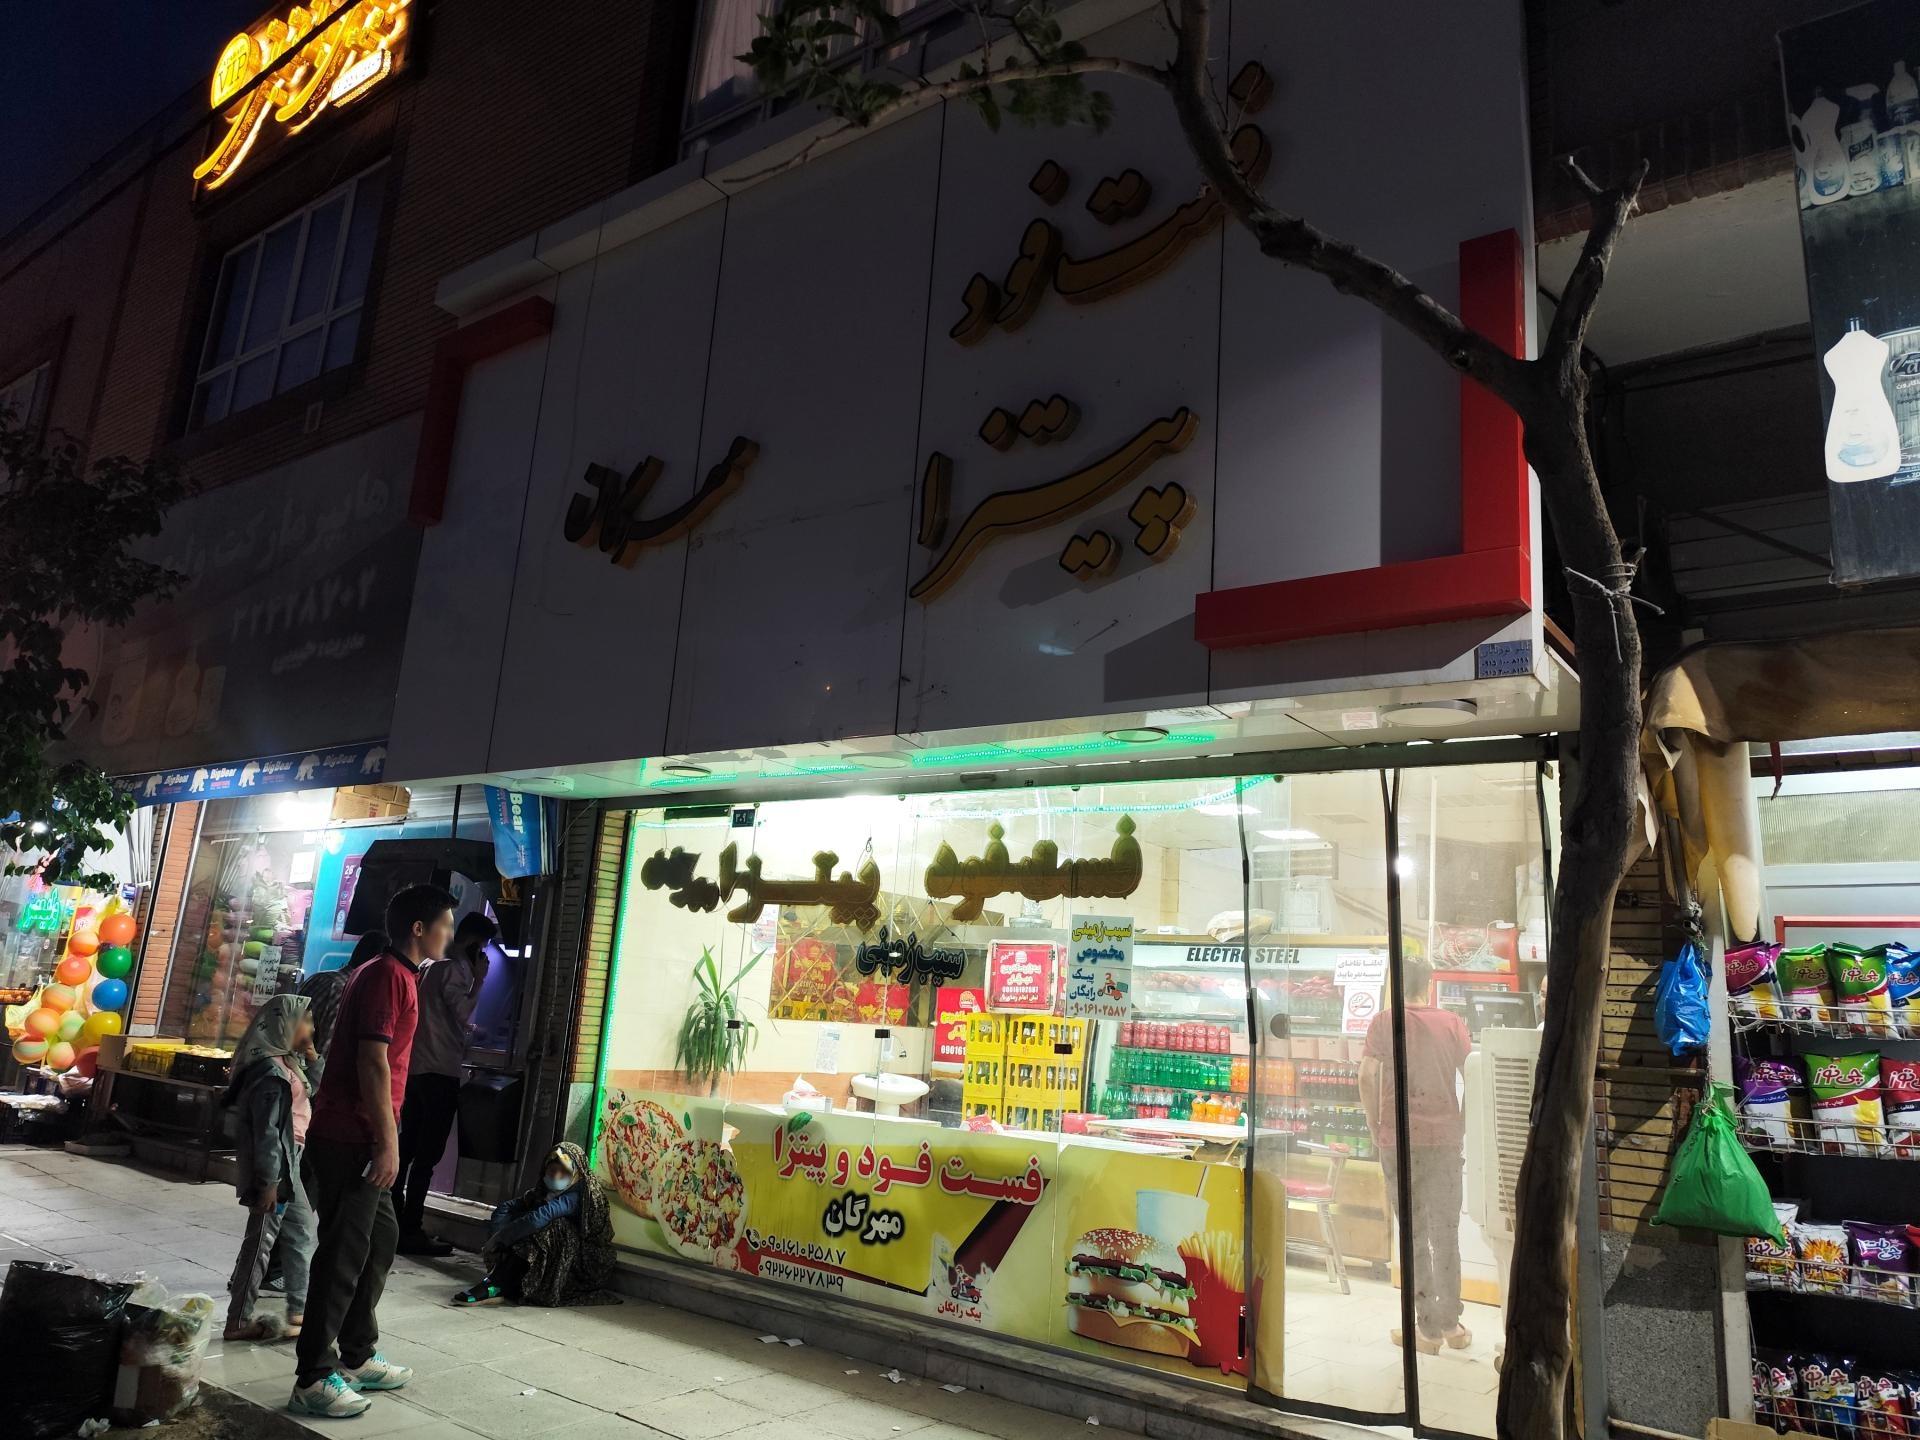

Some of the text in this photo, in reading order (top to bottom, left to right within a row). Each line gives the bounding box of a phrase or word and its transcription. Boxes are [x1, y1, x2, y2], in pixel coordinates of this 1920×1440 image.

[217, 51, 249, 94] VIP
[950, 159, 1070, 347] فود
[564, 436, 760, 571] مهرگان
[908, 393, 1200, 604] پیتزا
[210, 768, 238, 780] BigBear
[262, 760, 294, 774] BigBear
[509, 792, 525, 834] Bear
[1072, 921, 1132, 944] سیب زمینی
[856, 924, 966, 987] سیب زمینی
[1077, 945, 1125, 965] مخصوص
[1255, 948, 1300, 964] STEEL
[1071, 968, 1095, 985] پیک
[1069, 984, 1096, 1002] رایگان
[1070, 1001, 1127, 1017] ۰۹۰۱۶۱۰۲۵۸۷
[1814, 1063, 1864, 1086] چی توز
[773, 1123, 1047, 1207] فست فود و پیتزا
[826, 1195, 903, 1241] مهرگان
[761, 1236, 846, 1265] ۰۹۰۱۶۱۰۲۵۸۷
[758, 1260, 844, 1292] ۰۹۲۲۶۲۲۷۸۳۹
[937, 1300, 982, 1323] پیک رایگان
